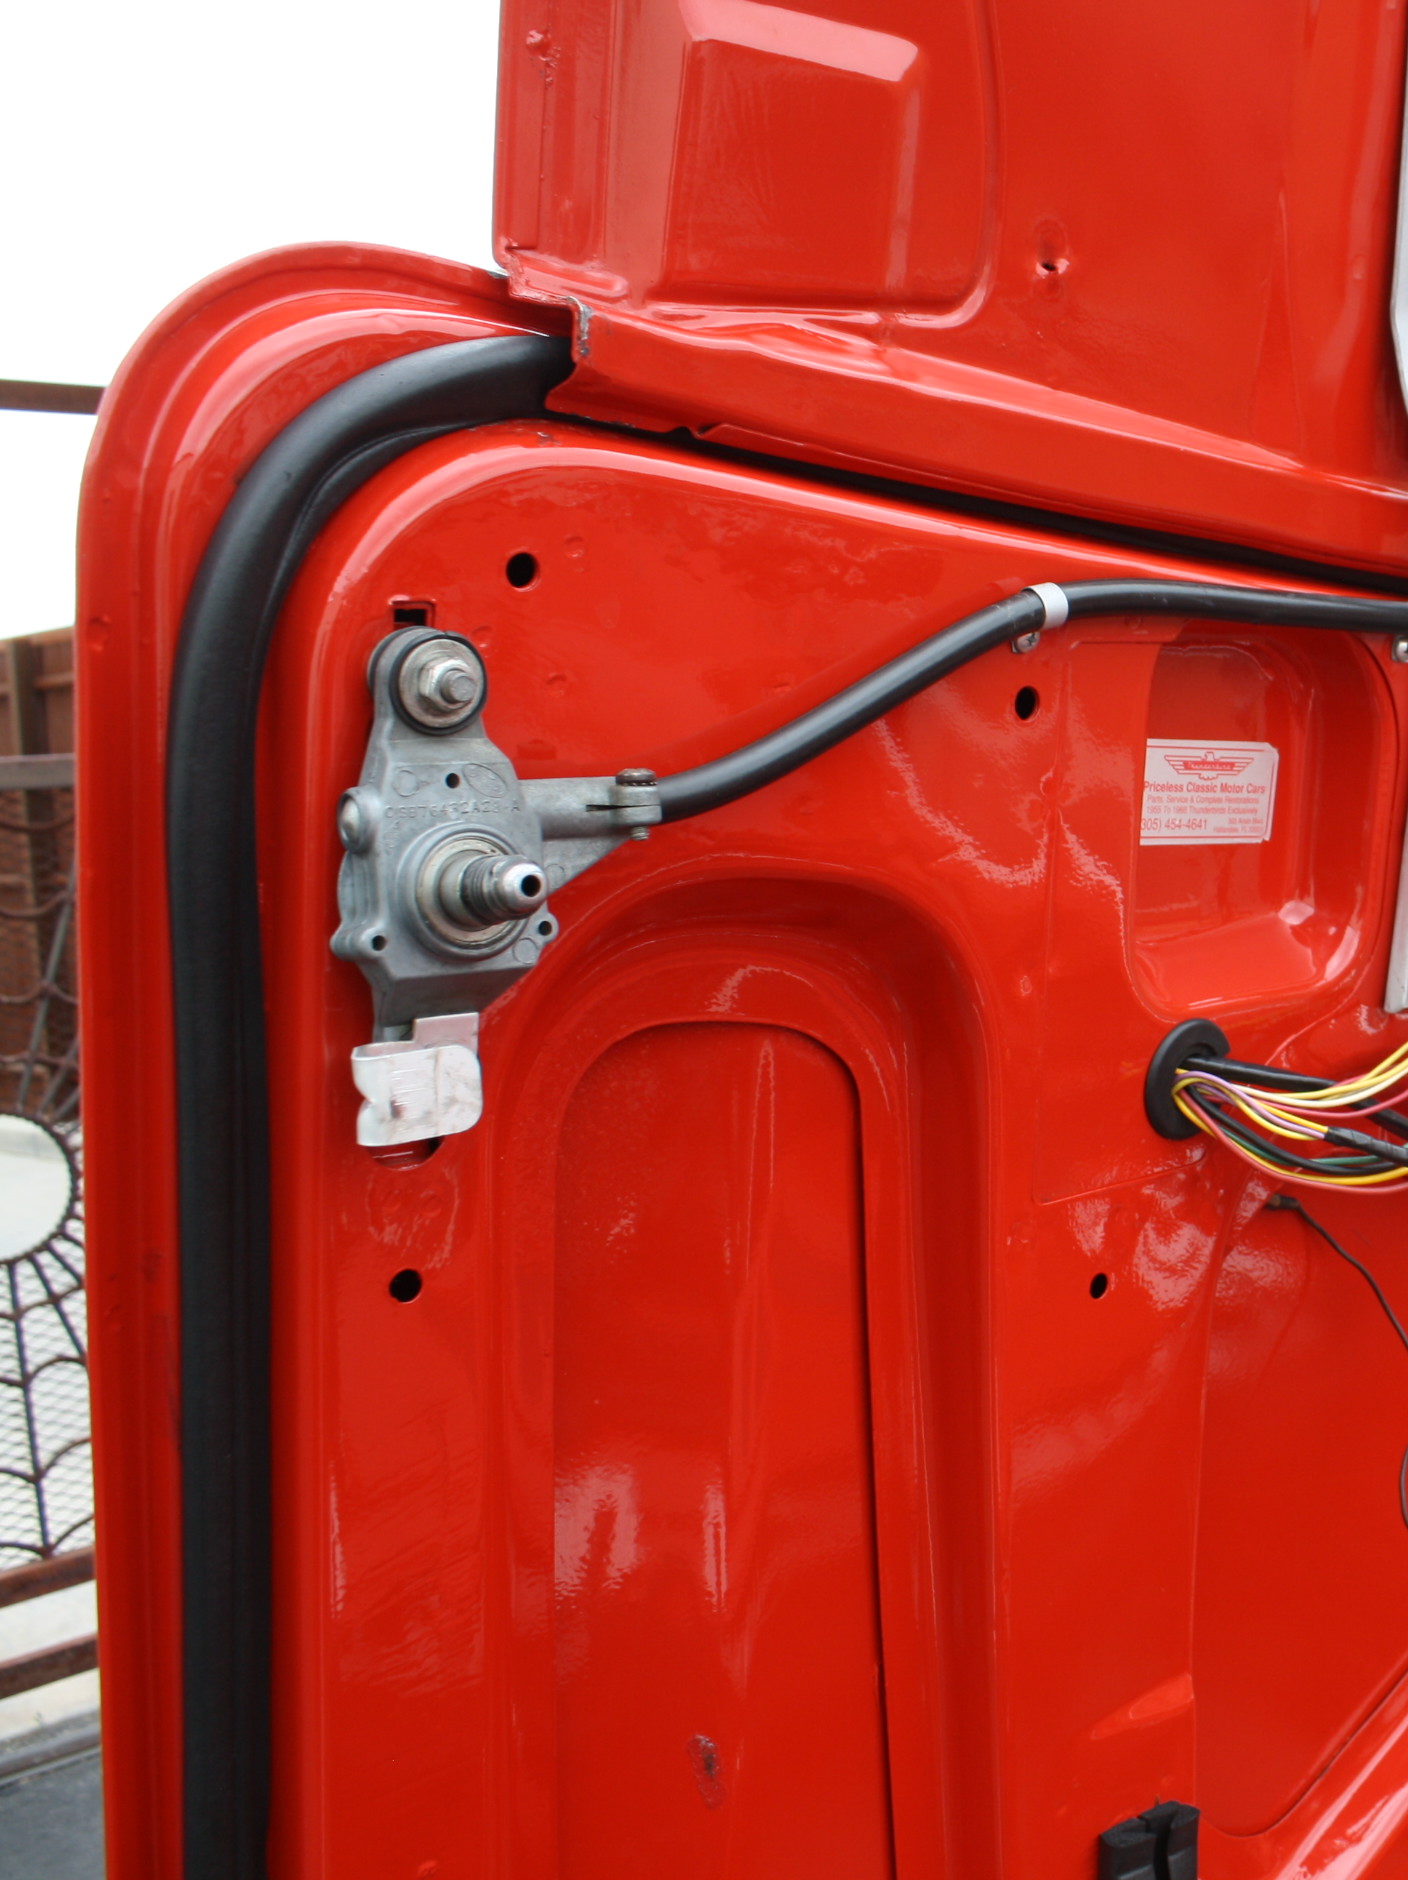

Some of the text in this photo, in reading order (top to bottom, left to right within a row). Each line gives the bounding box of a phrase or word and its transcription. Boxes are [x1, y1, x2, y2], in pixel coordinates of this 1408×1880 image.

[1144, 781, 1266, 795] Priceless Classic Motor Cars
[1164, 817, 1208, 831] 454-4641
